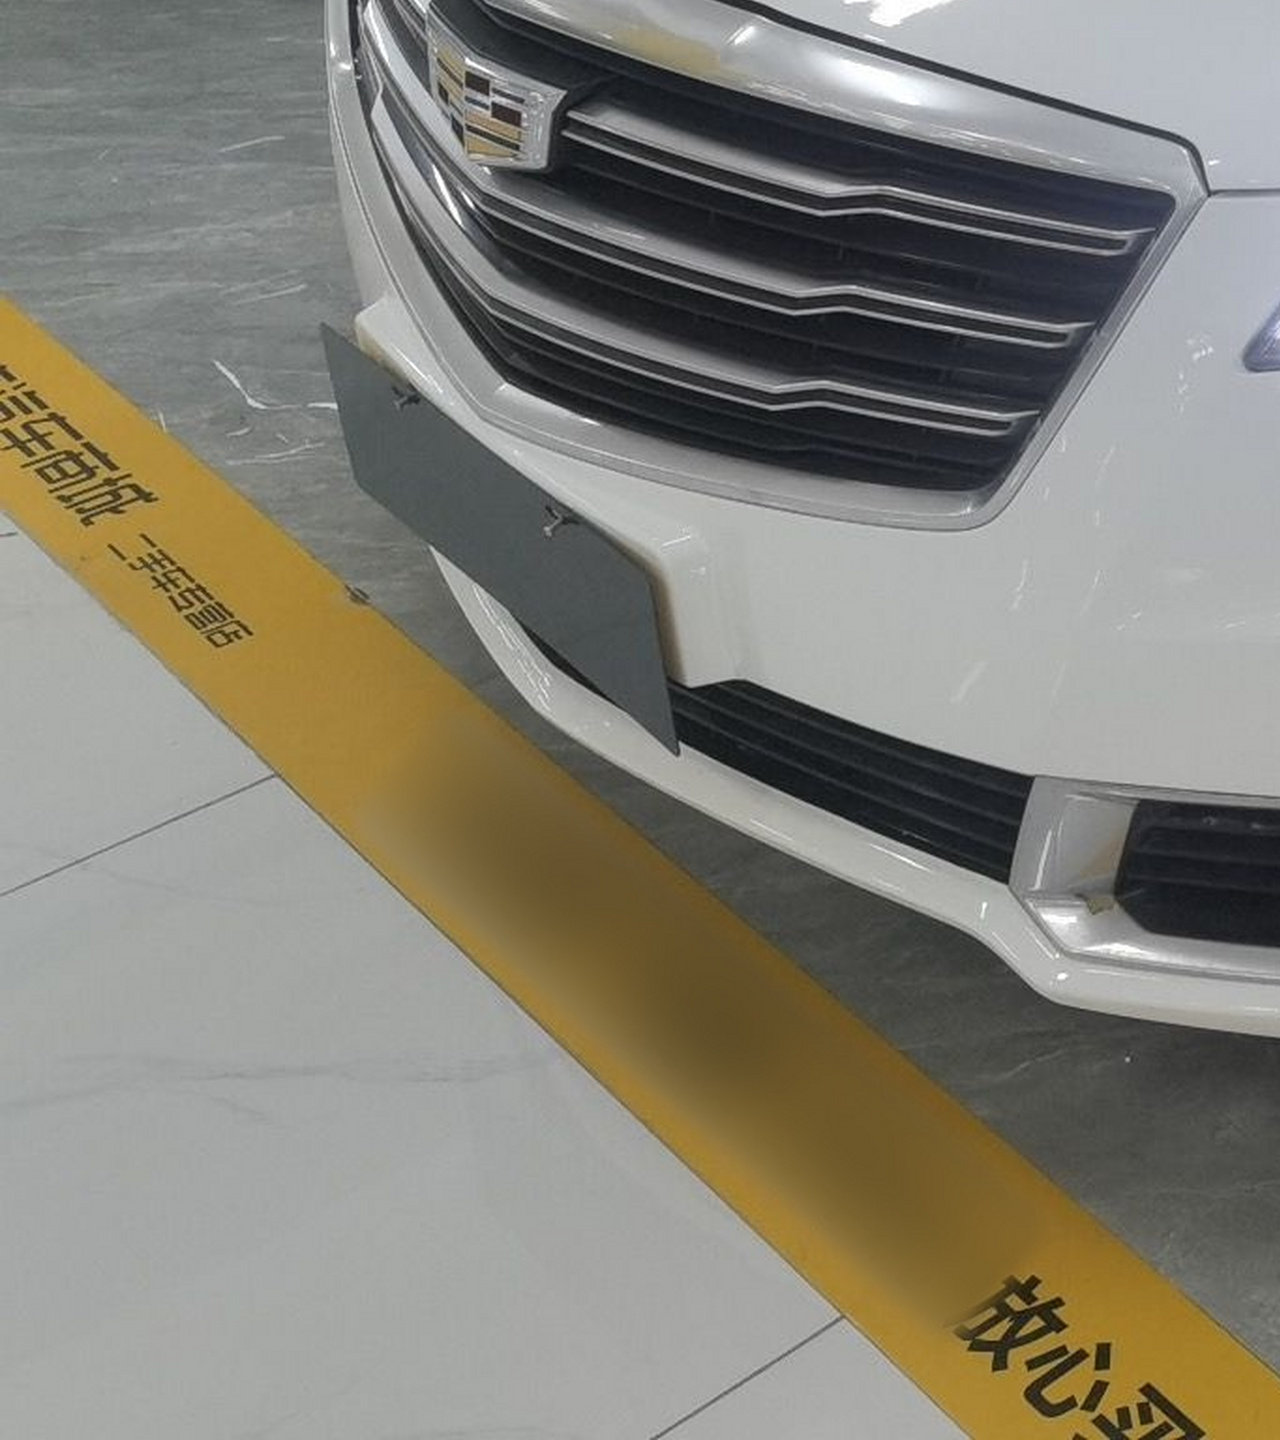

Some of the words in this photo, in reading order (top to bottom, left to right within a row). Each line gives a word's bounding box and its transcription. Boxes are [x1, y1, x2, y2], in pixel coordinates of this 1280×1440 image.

[0, 364, 159, 527] 汽车商城
[107, 532, 254, 648] 二手车专营店
